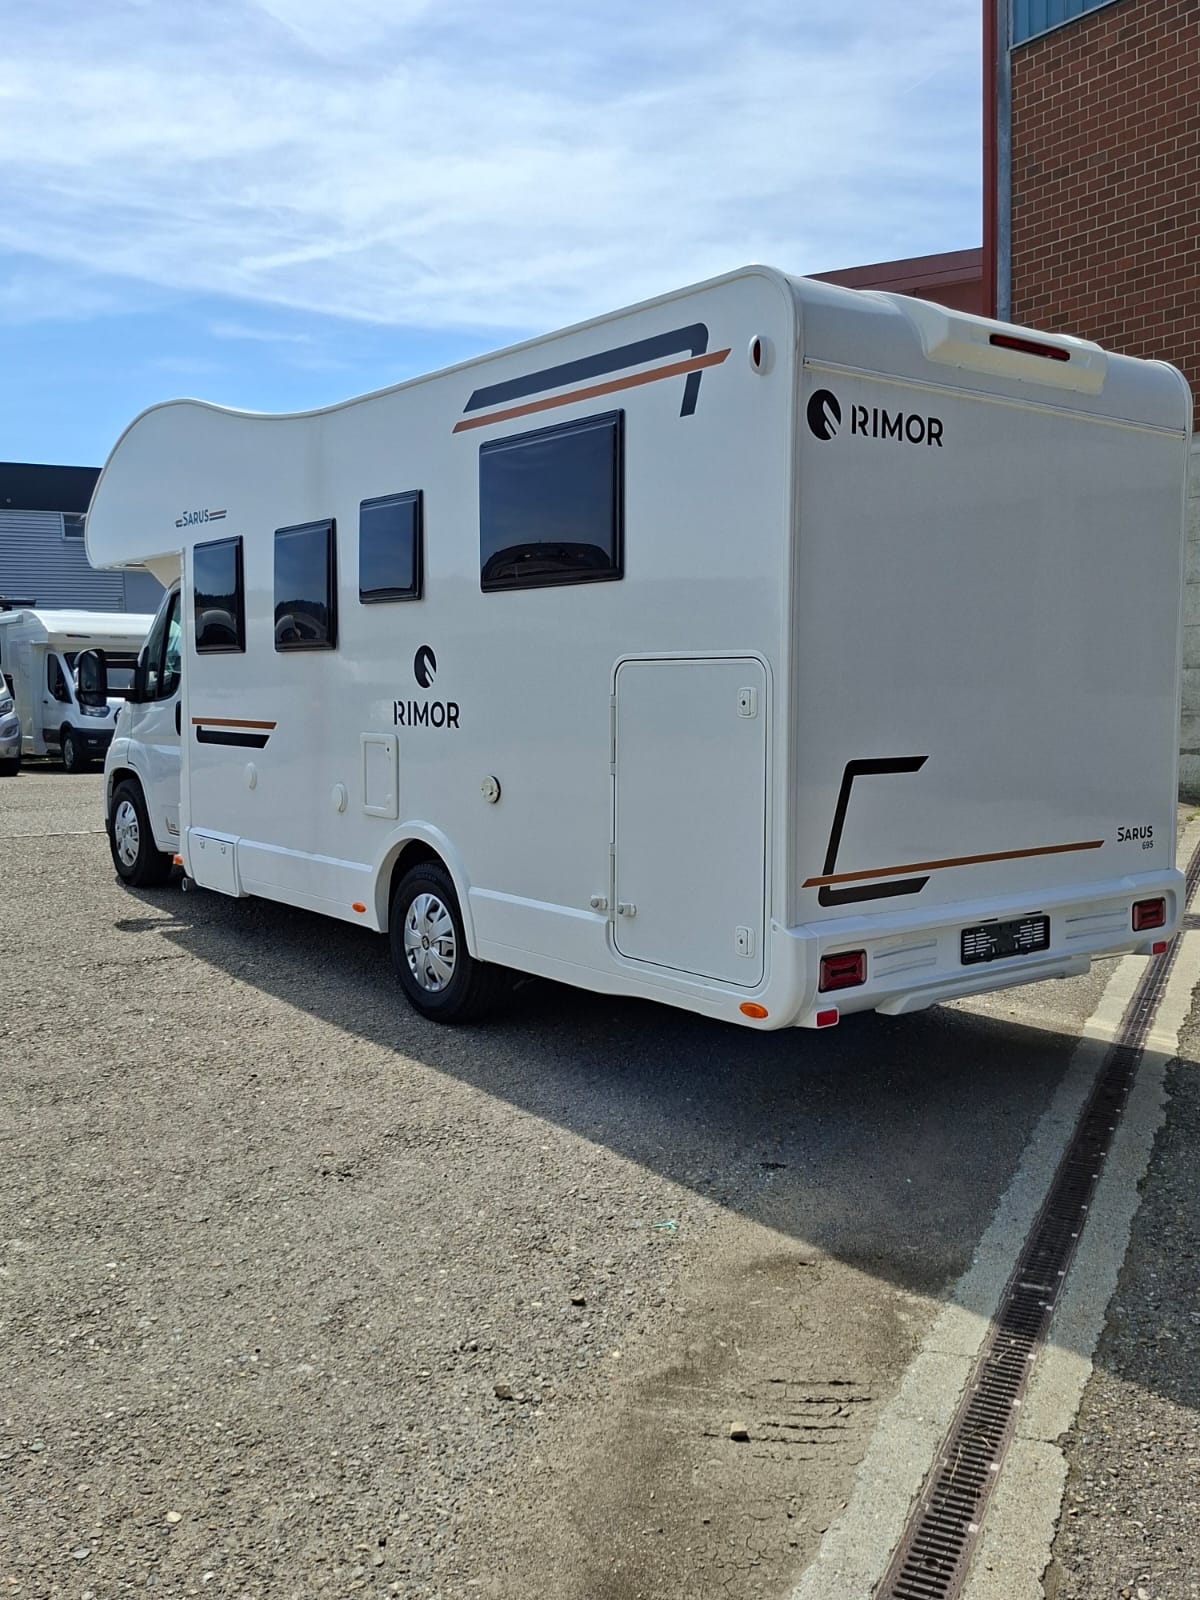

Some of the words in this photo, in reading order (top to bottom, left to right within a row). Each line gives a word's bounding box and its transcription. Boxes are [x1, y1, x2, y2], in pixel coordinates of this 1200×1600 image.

[851, 404, 944, 447] RIMOR
[182, 509, 209, 526] SARUS
[393, 700, 460, 729] RIMOR
[1117, 825, 1153, 842] SARUS
